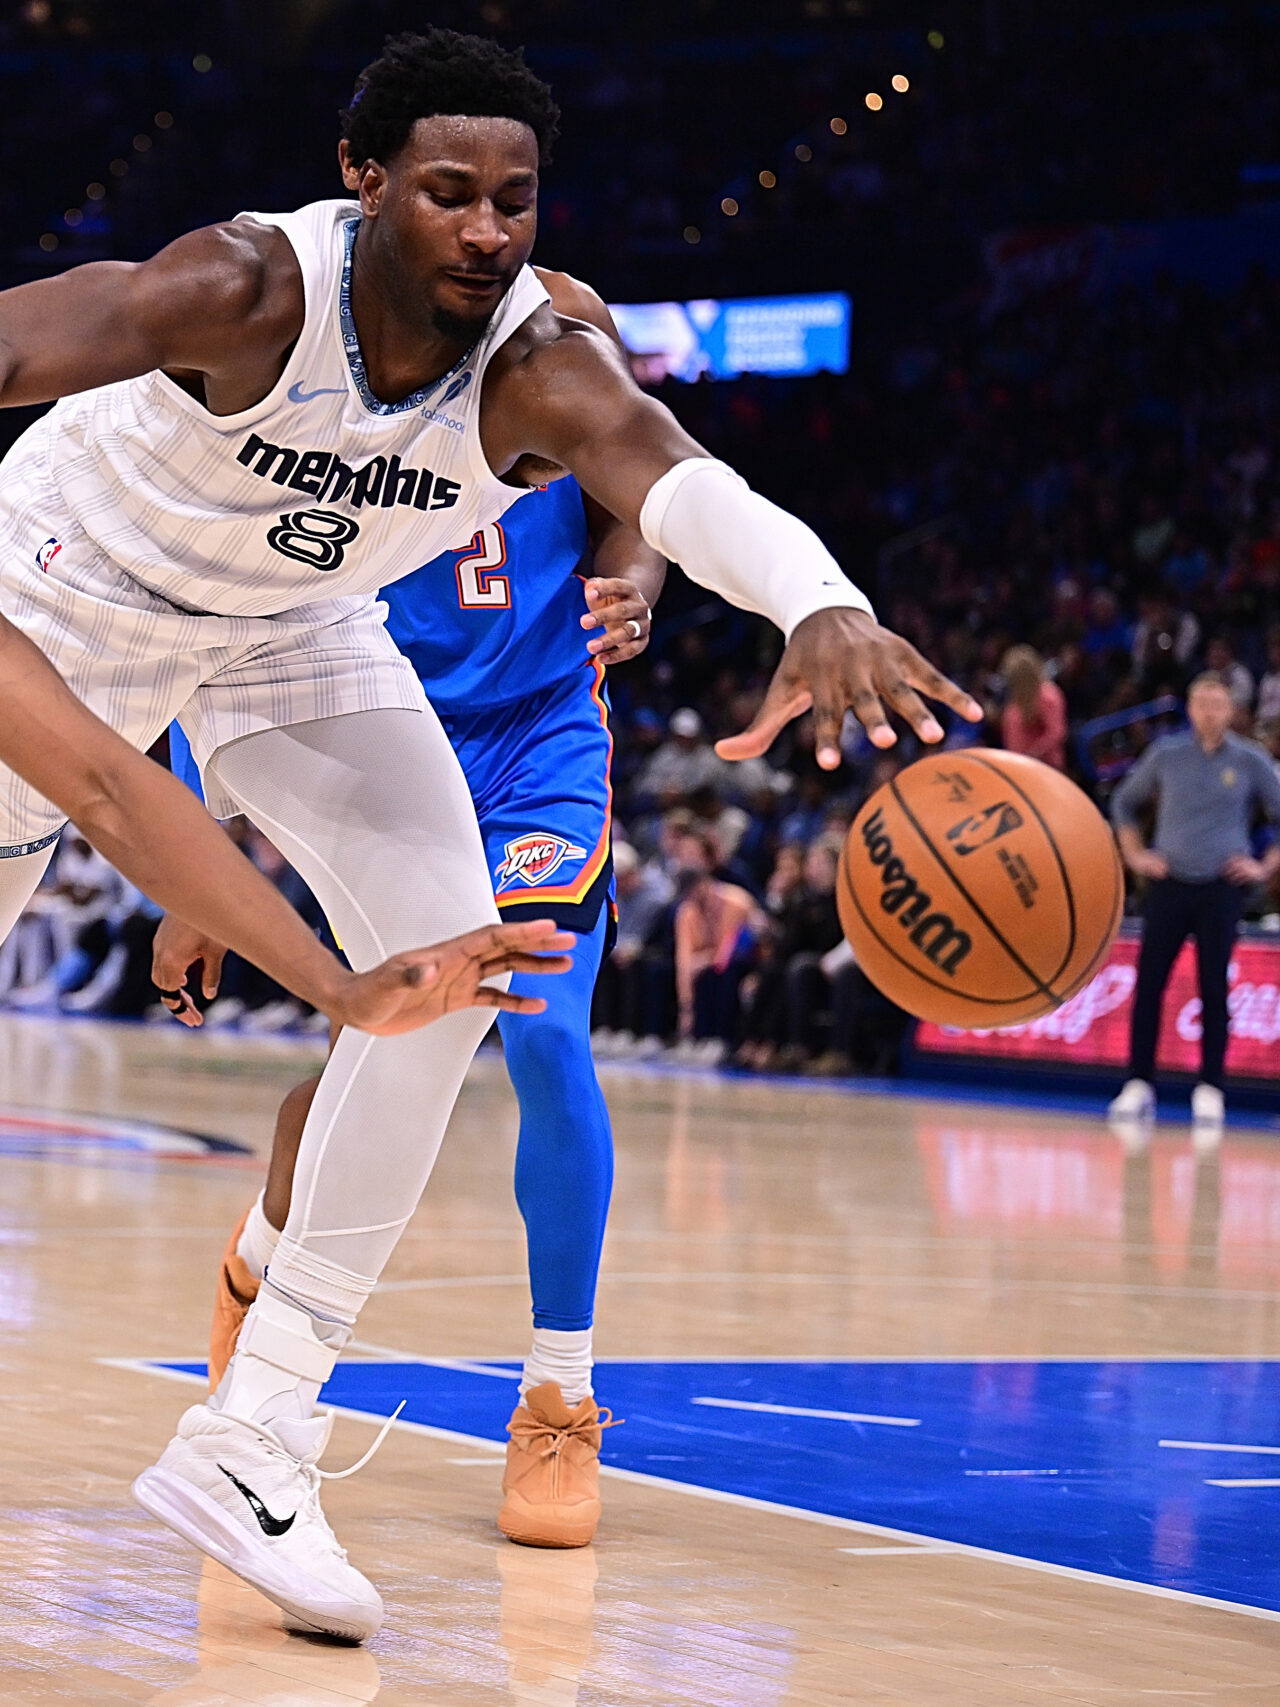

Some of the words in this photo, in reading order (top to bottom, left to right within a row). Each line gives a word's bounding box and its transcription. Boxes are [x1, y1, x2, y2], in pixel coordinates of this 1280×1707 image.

[266, 508, 360, 572] 8
[452, 520, 512, 609] 2
[503, 842, 555, 879] OKC
[861, 806, 972, 978] Wilson
